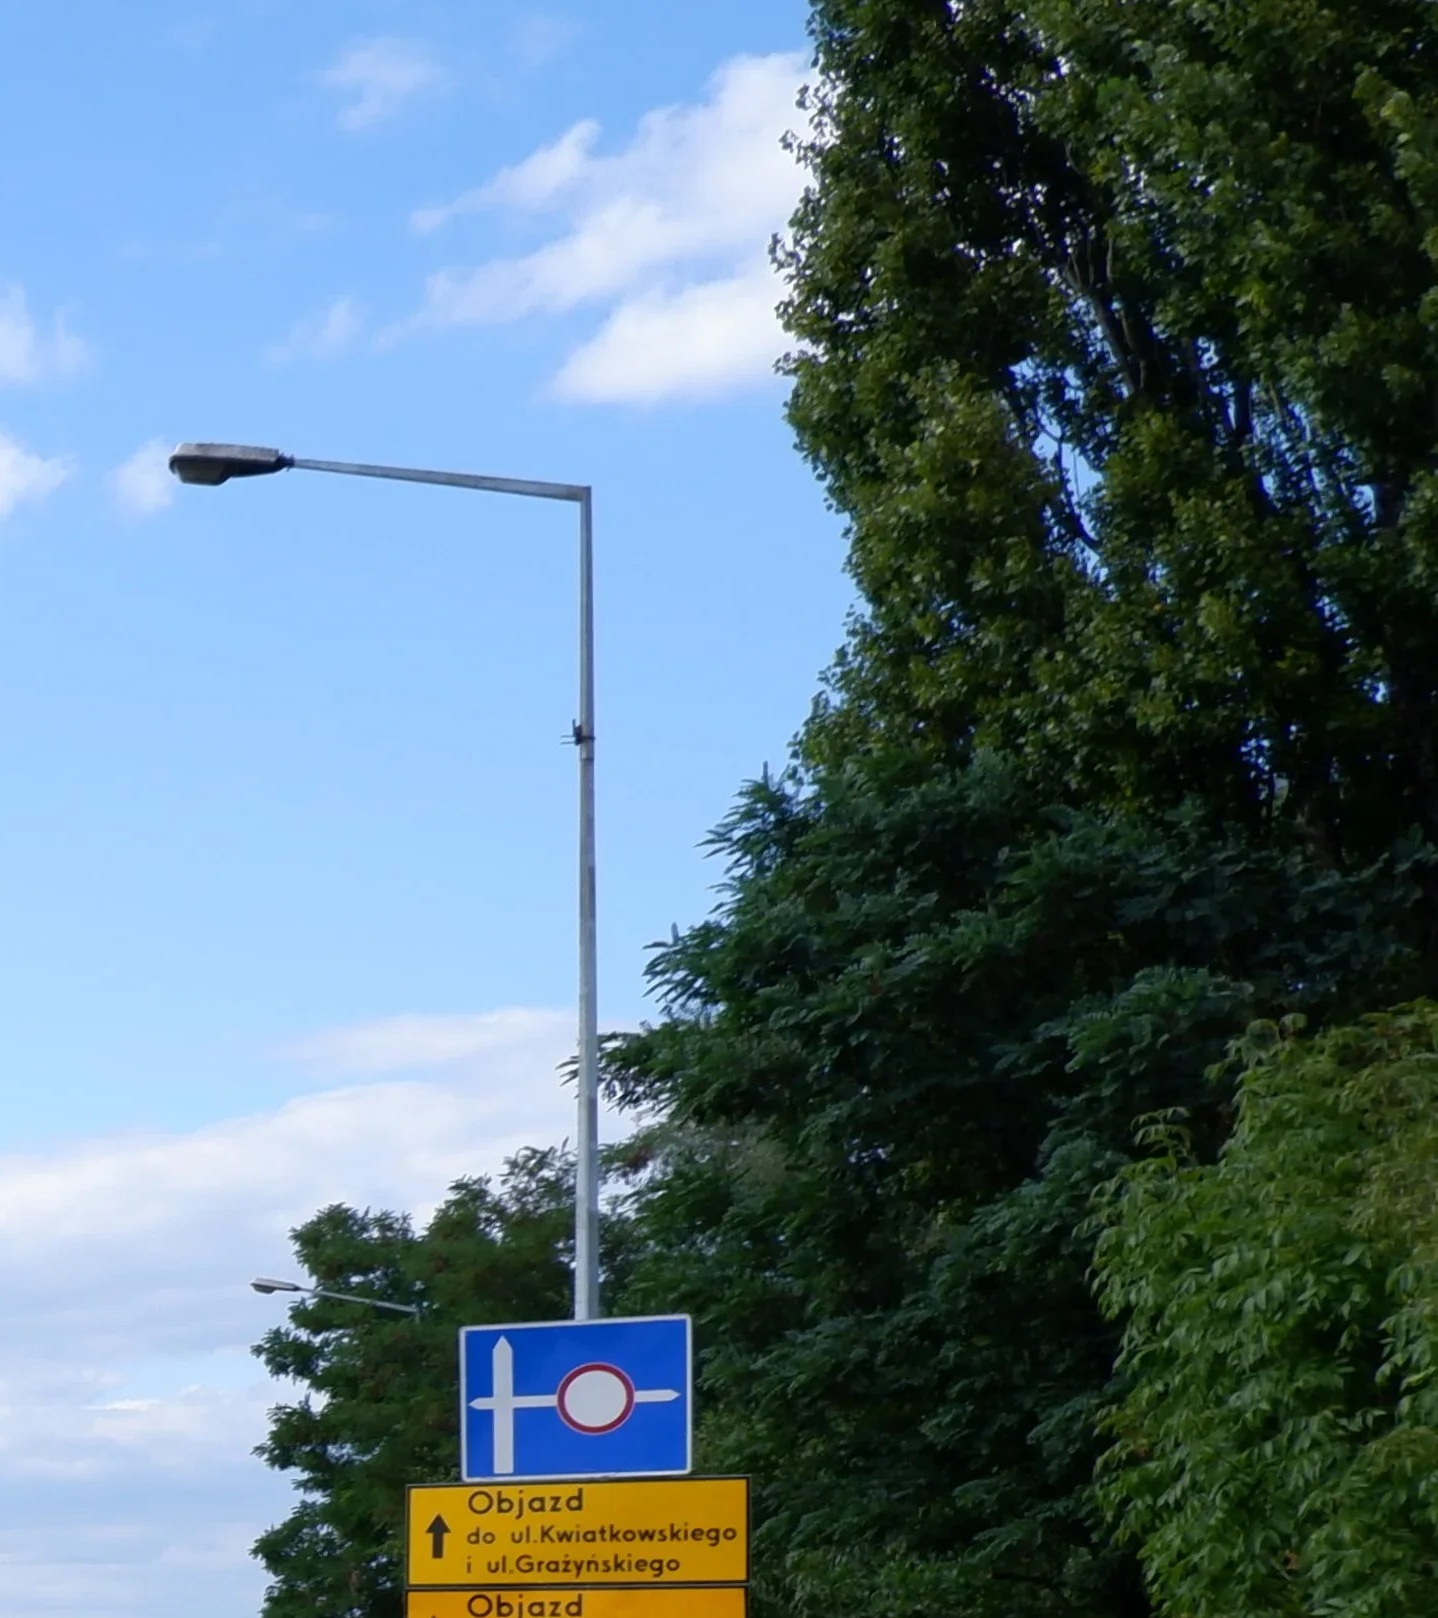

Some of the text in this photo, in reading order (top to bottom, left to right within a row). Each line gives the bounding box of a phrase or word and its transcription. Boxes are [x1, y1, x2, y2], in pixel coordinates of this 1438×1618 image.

[468, 1488, 584, 1519] Objazd
[466, 1527, 496, 1545] do
[466, 1556, 472, 1574] i
